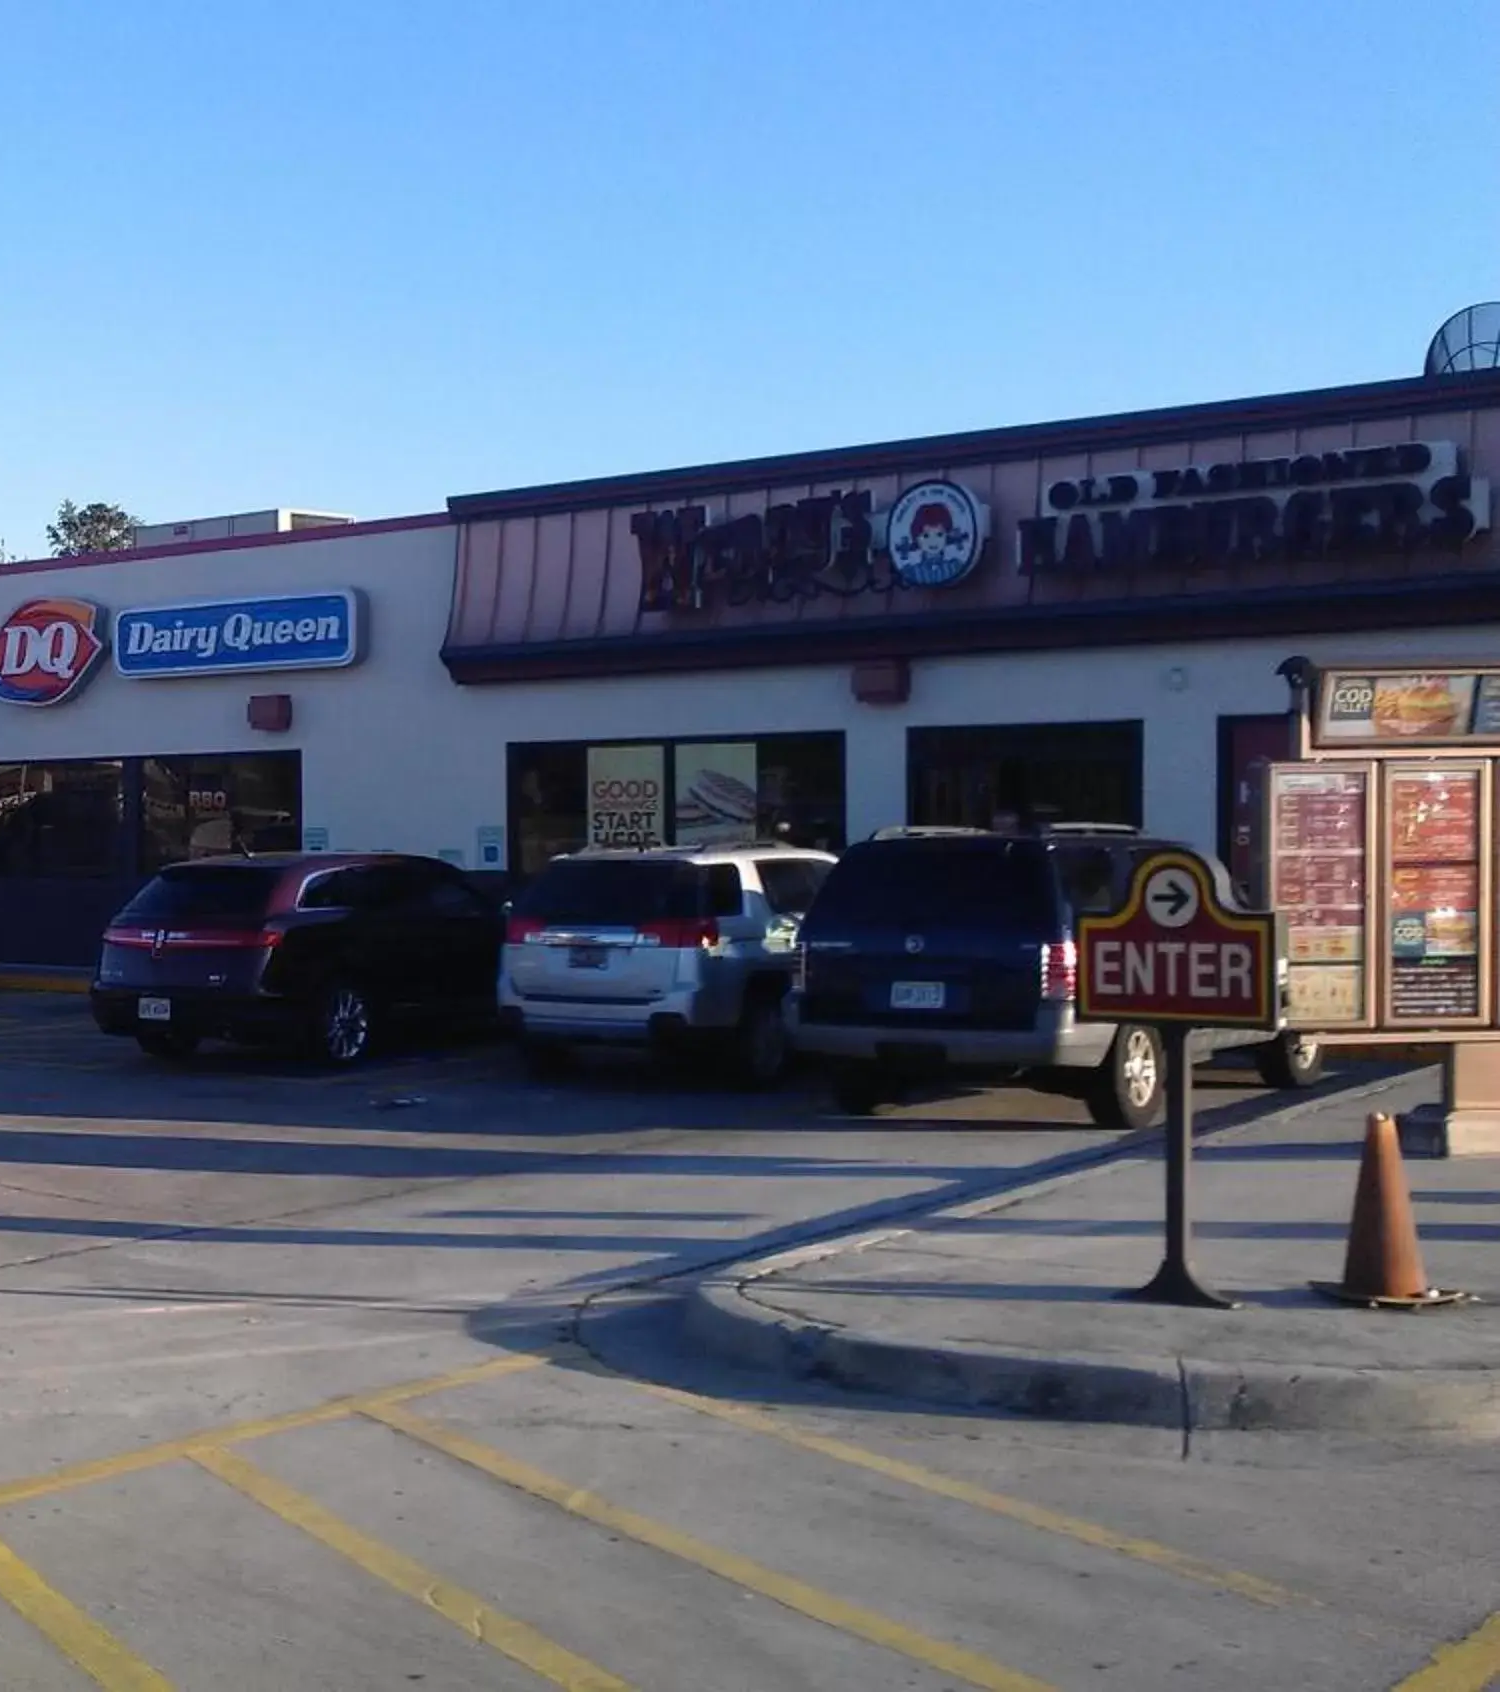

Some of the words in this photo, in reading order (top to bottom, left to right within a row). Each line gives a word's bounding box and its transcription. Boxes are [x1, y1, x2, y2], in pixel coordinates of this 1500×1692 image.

[1047, 475, 1138, 510] OLD
[1152, 443, 1431, 499] FASHIONED
[1017, 475, 1475, 576] HAMBURGERS
[2, 621, 79, 680] DQ
[126, 620, 218, 657] Dairy
[223, 613, 340, 652] Queen
[1335, 688, 1372, 702] COD
[593, 780, 658, 798] GOOD
[593, 811, 656, 829] START
[1095, 941, 1252, 998] ENTER
